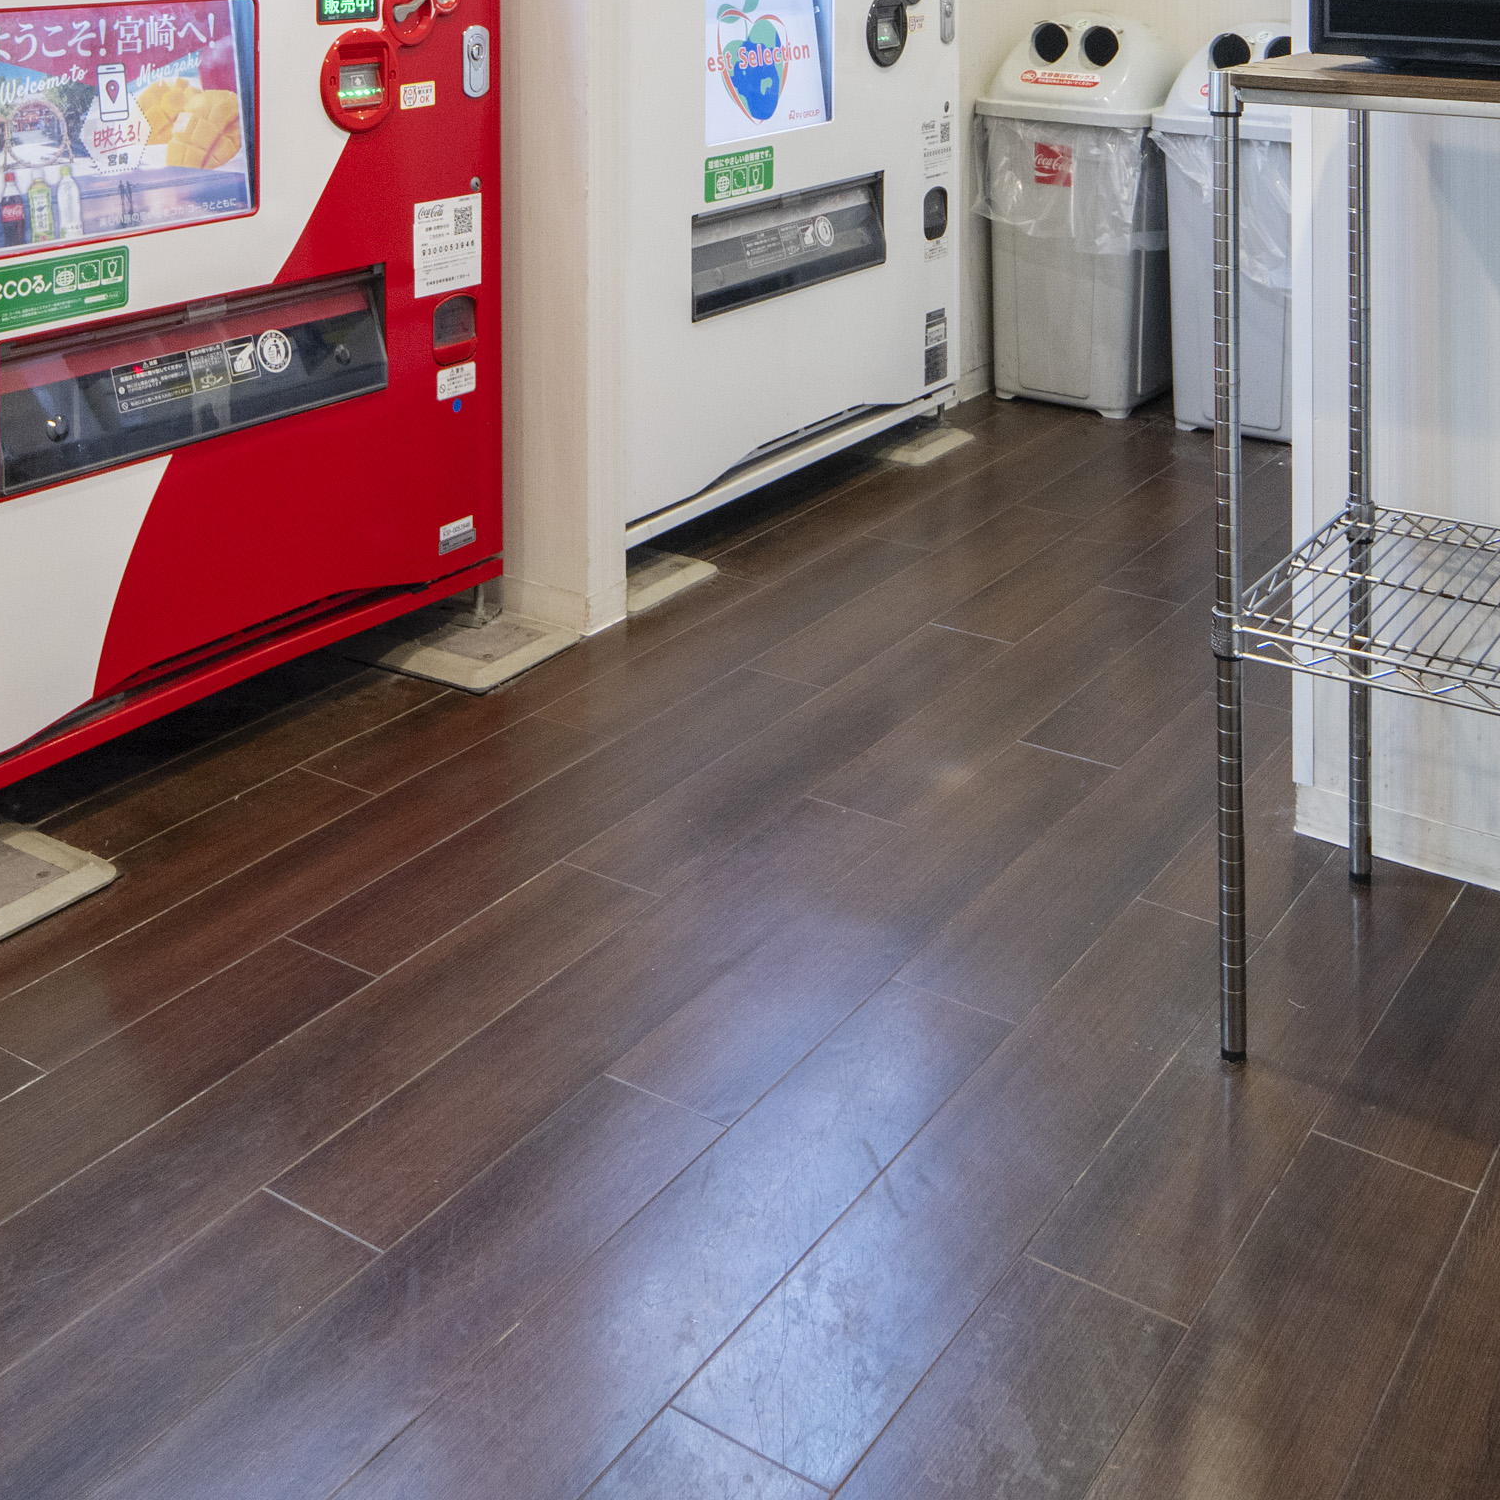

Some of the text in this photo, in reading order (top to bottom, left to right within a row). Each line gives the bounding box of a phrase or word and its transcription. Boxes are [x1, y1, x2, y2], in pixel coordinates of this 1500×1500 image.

[136, 53, 202, 89] Miyazaki
[1041, 71, 1096, 80] 空容器回収ボックス
[0, 65, 88, 105] Welcome to
[93, 121, 141, 148] 映える!
[107, 153, 129, 167] 宮崎
[707, 150, 772, 169] 環境にやさしい自販機です。
[418, 204, 445, 220] Coca-Cola
